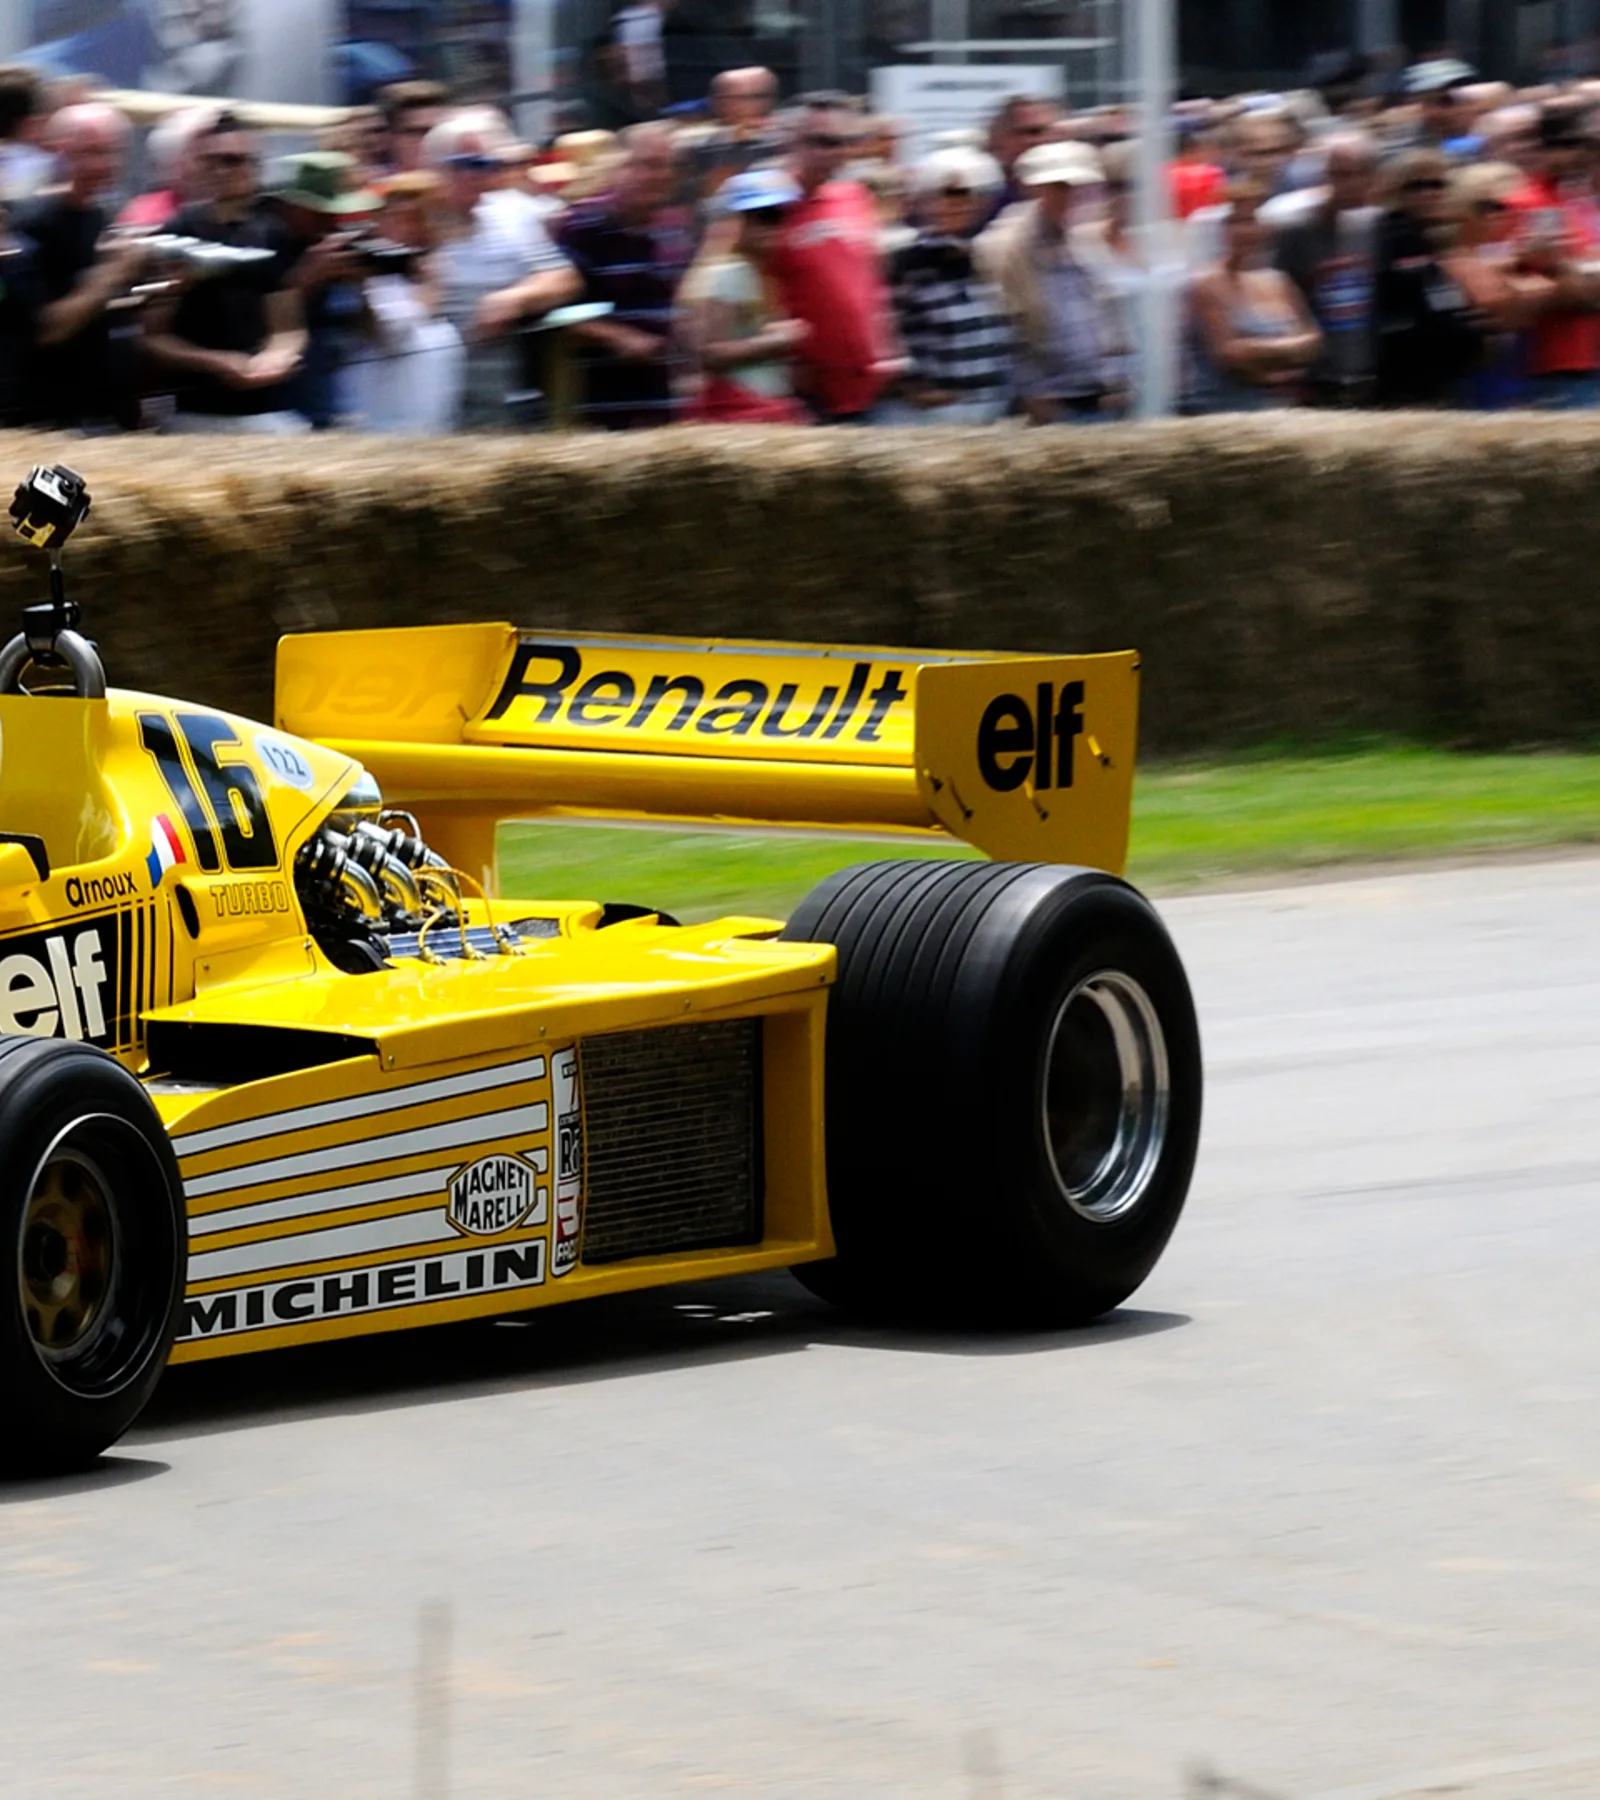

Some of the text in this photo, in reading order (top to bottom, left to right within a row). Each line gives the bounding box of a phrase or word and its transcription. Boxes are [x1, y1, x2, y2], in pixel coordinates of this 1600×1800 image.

[486, 644, 907, 742] Renault
[262, 744, 306, 777] 122
[978, 681, 1084, 792] elf
[137, 712, 277, 872] 16
[209, 881, 289, 917] TURBO
[454, 1160, 529, 1200] MAGNETI
[454, 1194, 529, 1230] MARELLI
[182, 1244, 540, 1337] MICHELIN
